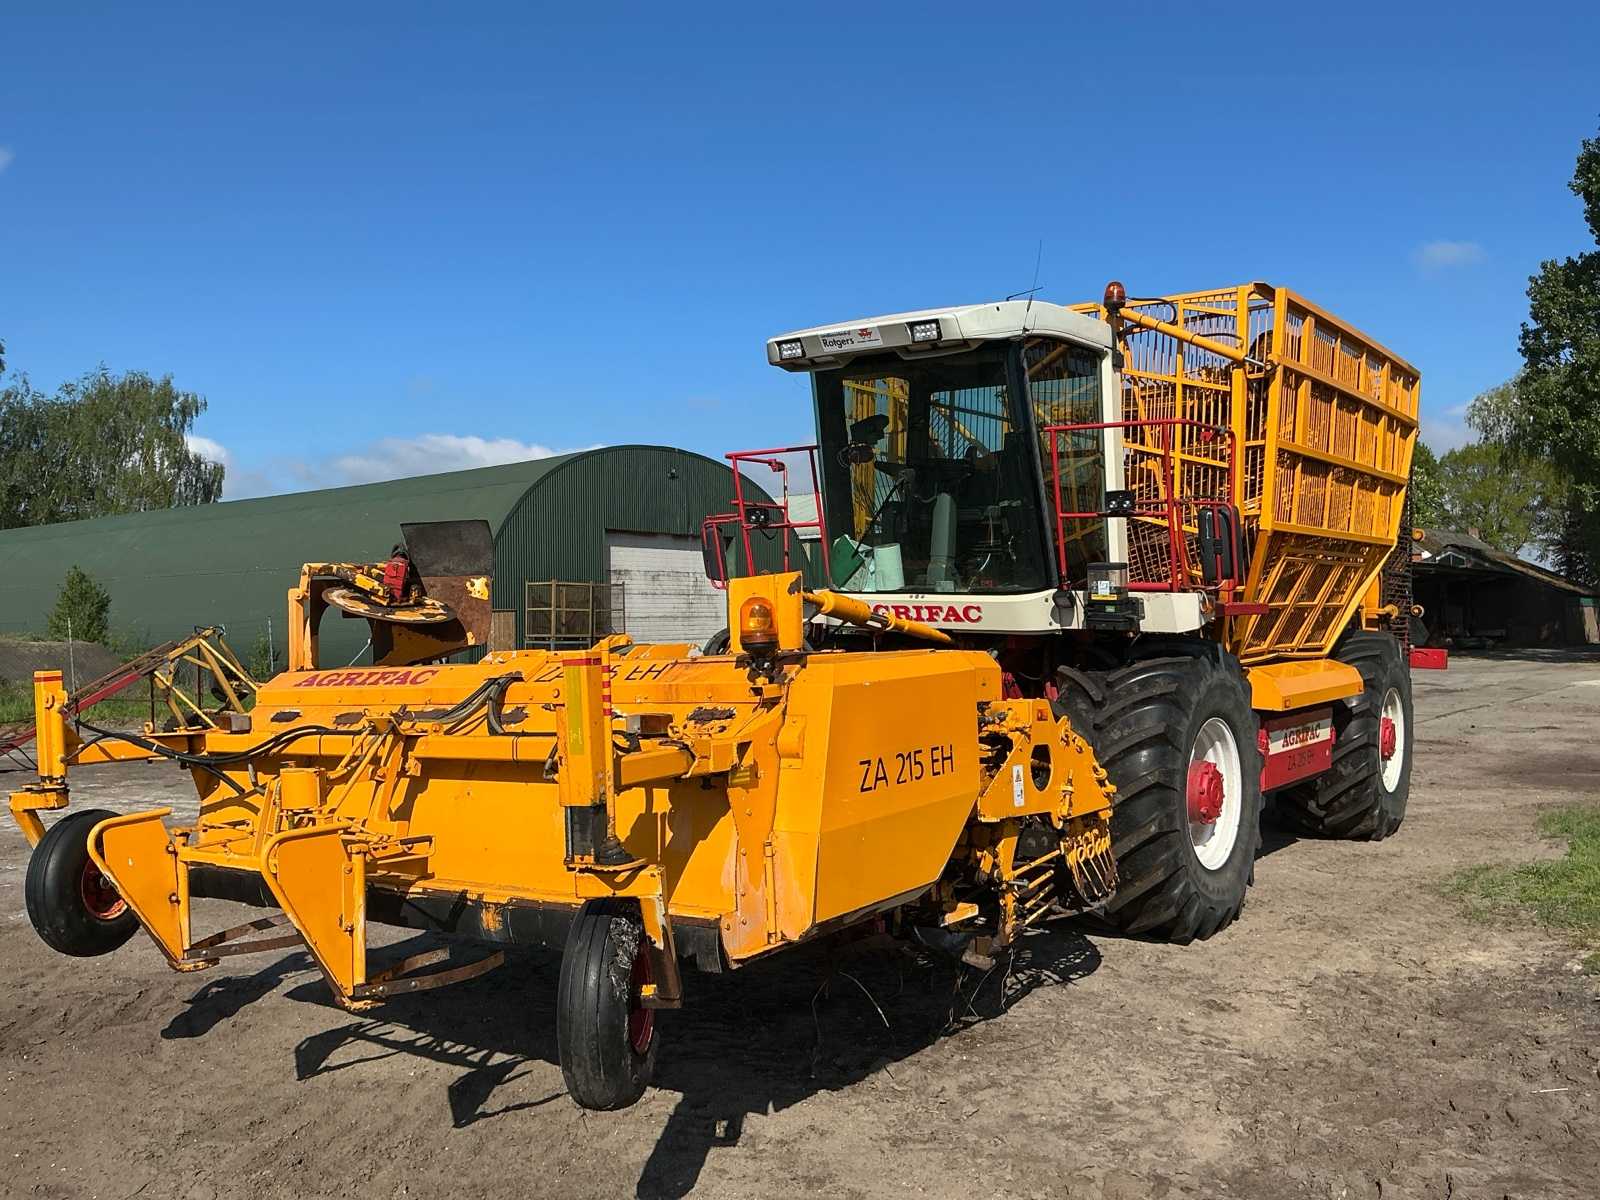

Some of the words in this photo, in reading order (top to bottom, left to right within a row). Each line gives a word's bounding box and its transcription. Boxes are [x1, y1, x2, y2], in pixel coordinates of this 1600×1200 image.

[822, 338, 855, 349] Rotgers
[294, 670, 440, 688] AGRIFAC
[1282, 722, 1321, 748] AGRIFAC
[859, 756, 889, 793] ZA
[896, 749, 925, 785] 215
[930, 744, 954, 777] EH
